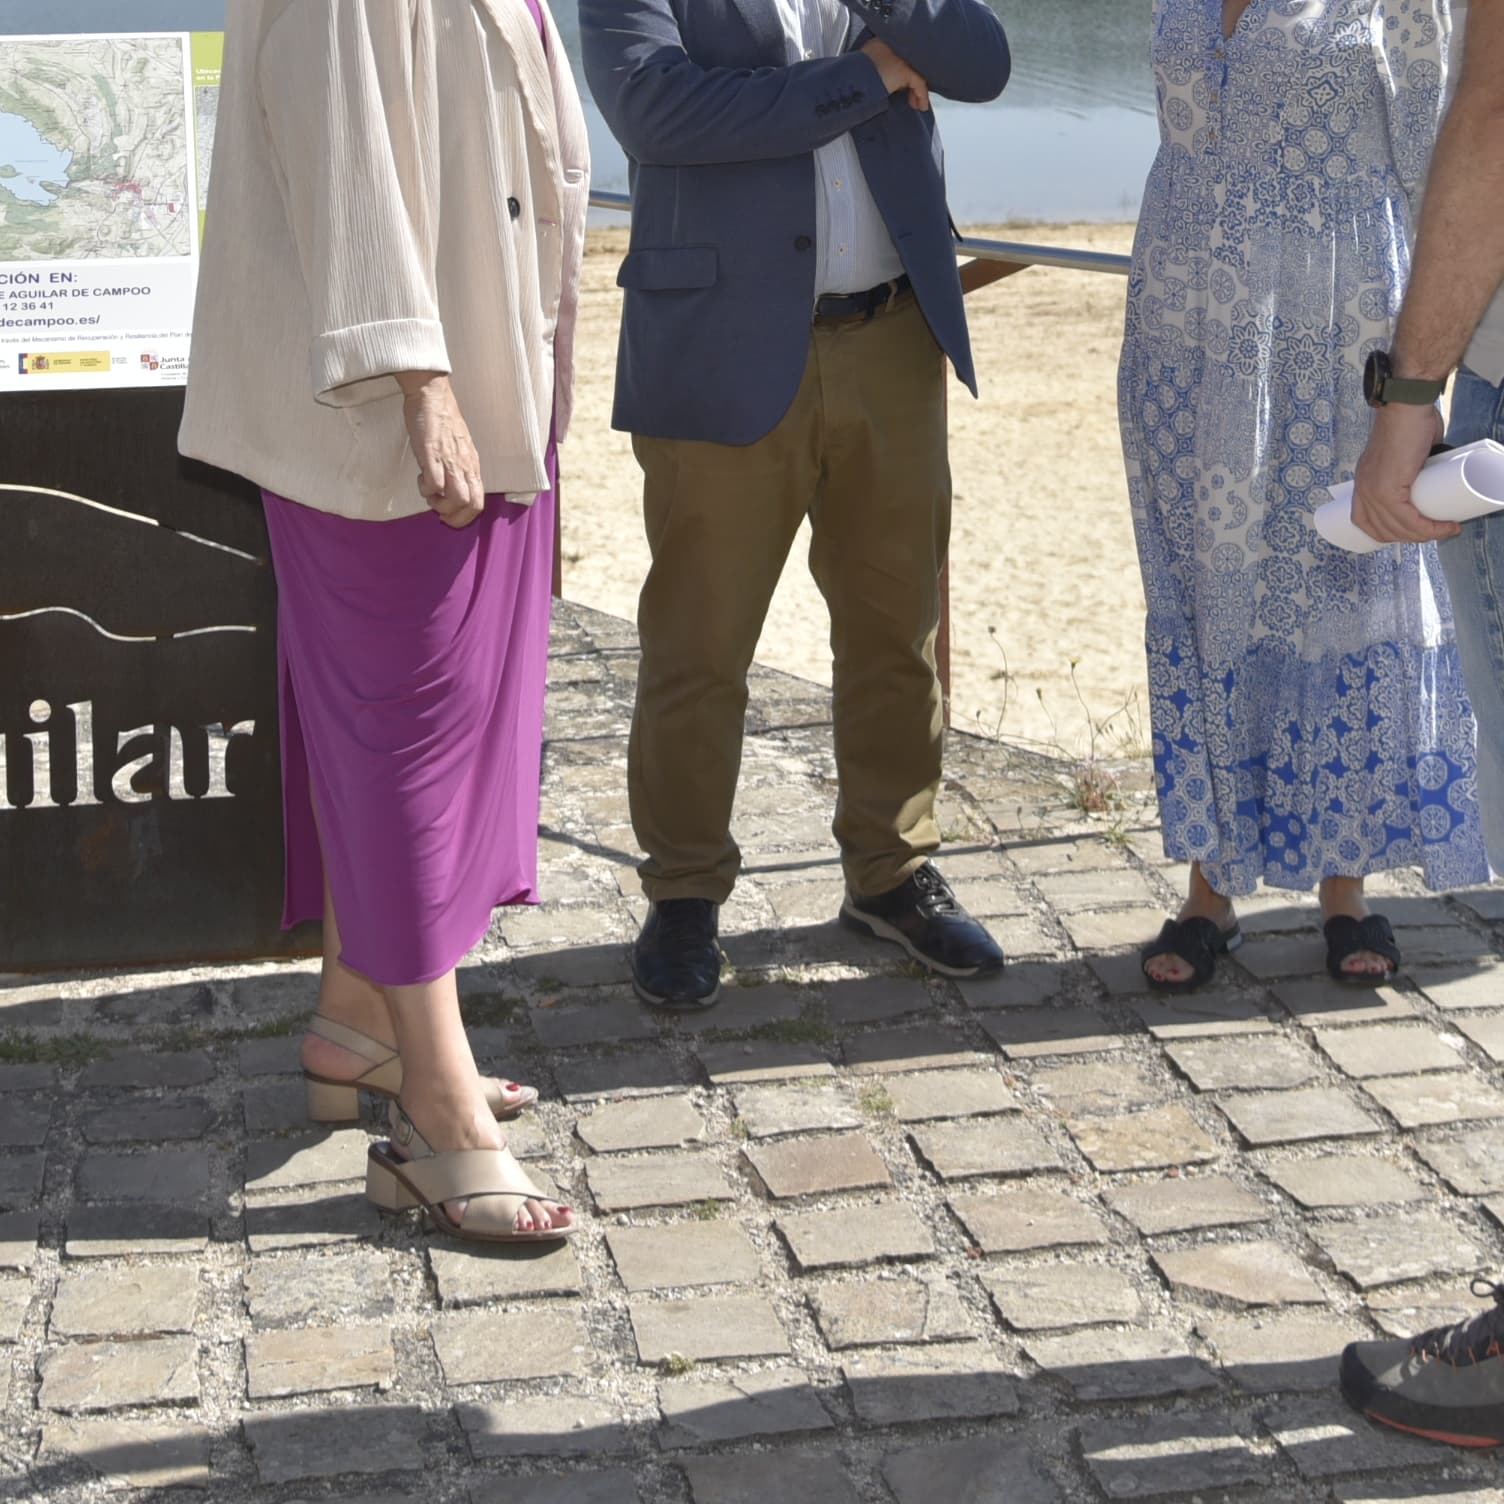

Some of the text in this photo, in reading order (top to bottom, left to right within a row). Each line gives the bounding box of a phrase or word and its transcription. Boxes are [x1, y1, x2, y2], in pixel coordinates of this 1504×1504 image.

[49, 272, 78, 284] EN:
[8, 288, 68, 299] AGUILAR
[71, 287, 90, 298] DE
[92, 286, 152, 297] CAMPOO
[3, 302, 17, 312] 12
[19, 301, 36, 311] 36
[39, 301, 54, 311] 41
